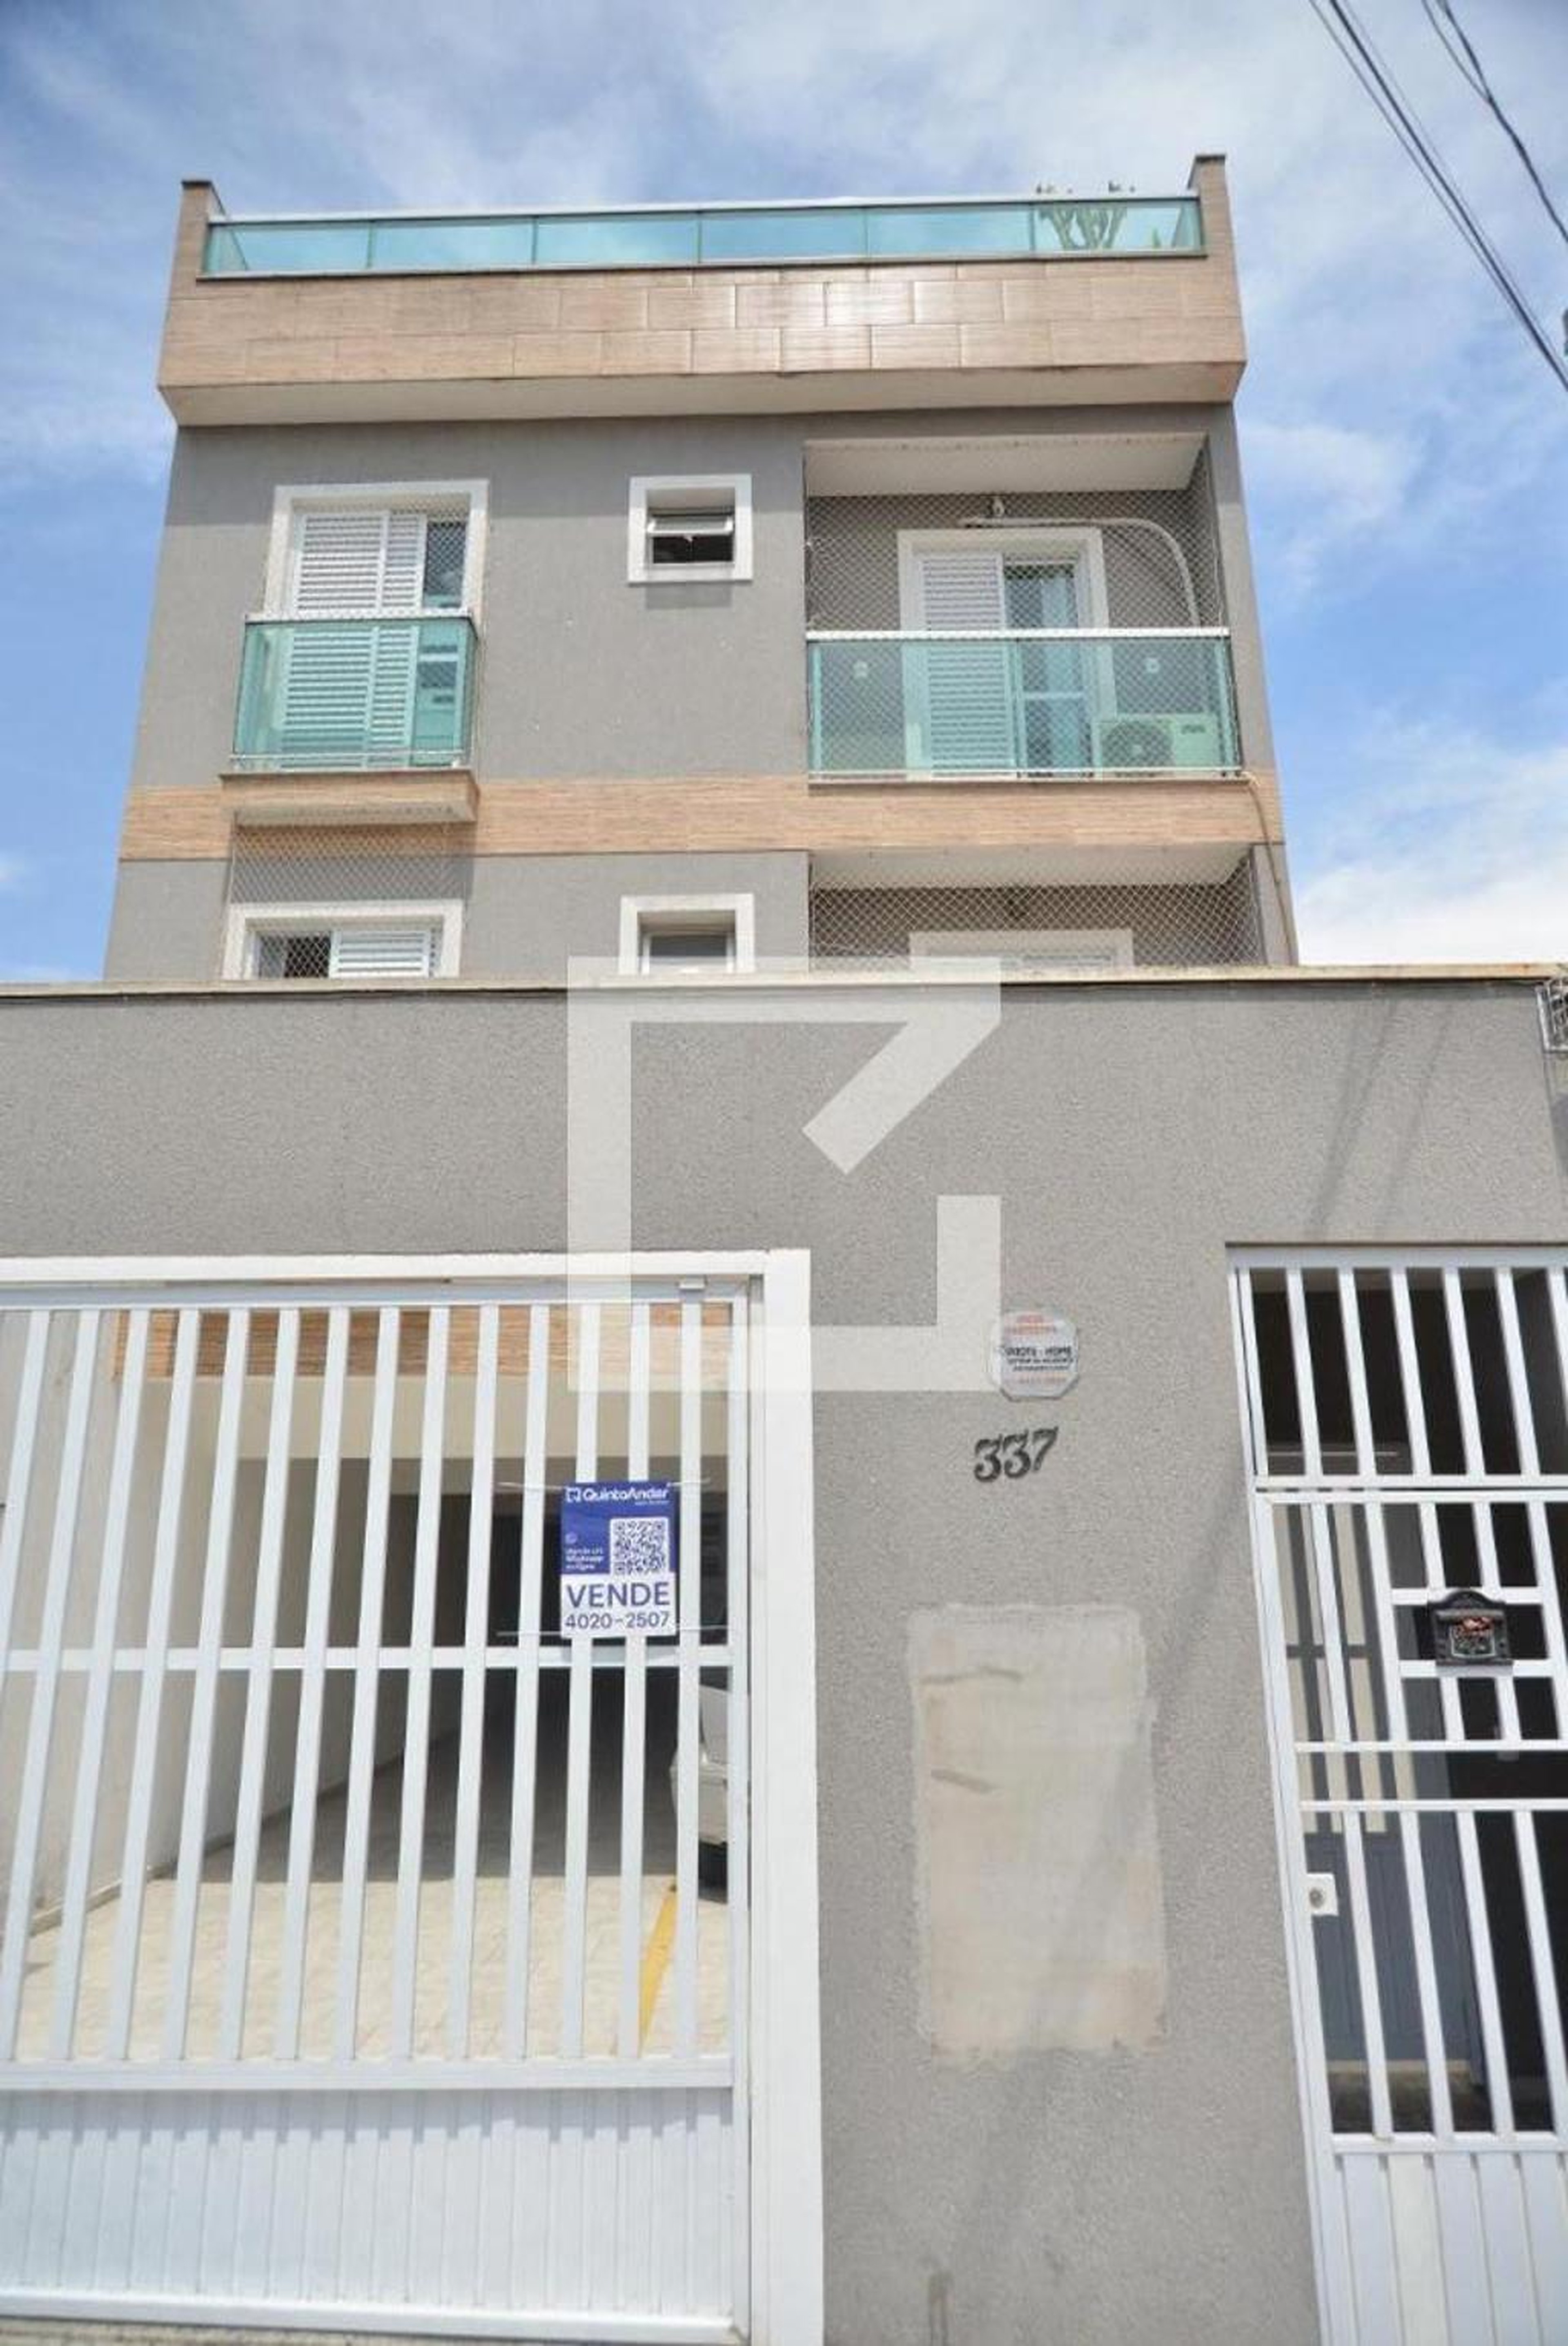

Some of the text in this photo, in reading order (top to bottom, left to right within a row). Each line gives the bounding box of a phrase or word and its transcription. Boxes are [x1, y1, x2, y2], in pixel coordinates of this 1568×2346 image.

[974, 1426, 1059, 1483] 337
[566, 1582, 670, 1608] VENDE
[566, 1611, 670, 1629] 4020-2507
